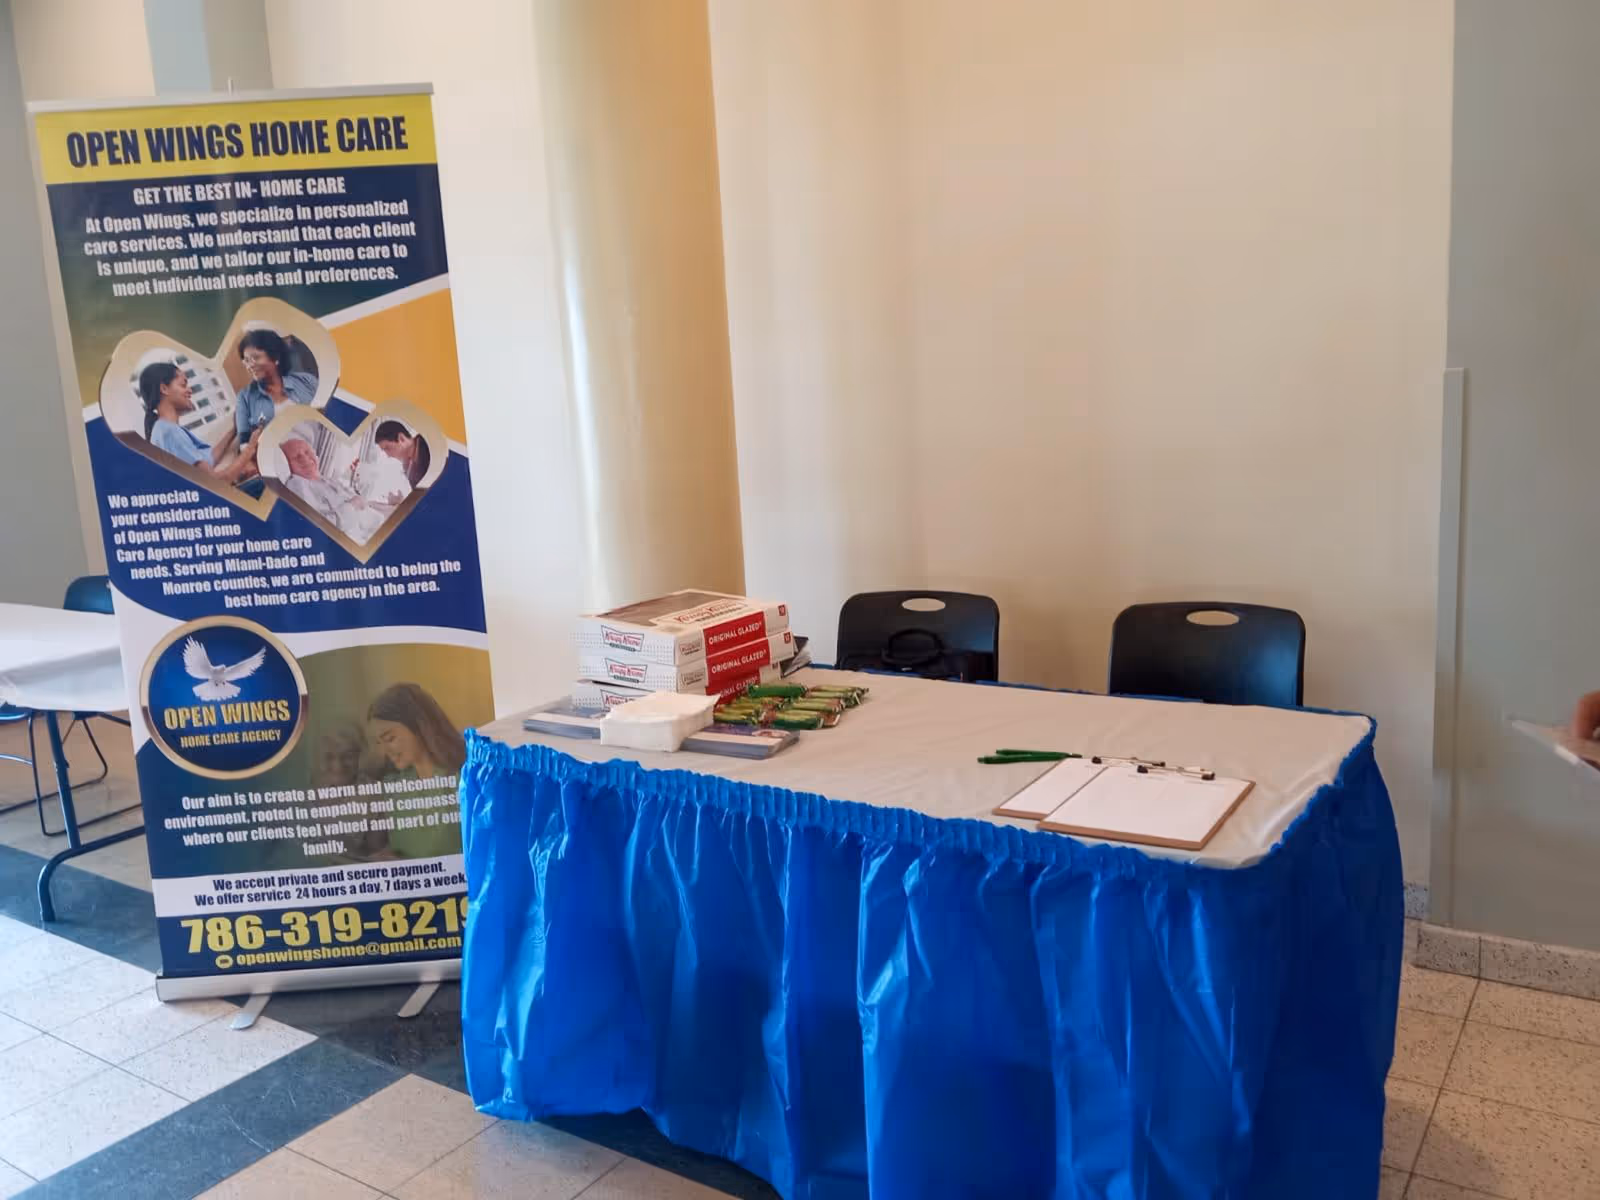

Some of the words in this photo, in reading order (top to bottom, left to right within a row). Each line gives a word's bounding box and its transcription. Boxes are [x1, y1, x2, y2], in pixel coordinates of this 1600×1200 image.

[66, 129, 141, 168] OPEN
[144, 123, 245, 163] WINGS
[249, 119, 331, 157] HOME
[336, 115, 409, 153] CARE
[133, 187, 160, 205] GET
[164, 185, 193, 203] THE
[194, 182, 233, 201] BEST
[235, 181, 257, 199] IN-
[260, 178, 304, 197] HOME
[306, 176, 346, 195] CARE
[85, 218, 101, 234] At
[103, 216, 142, 234] Open
[143, 213, 195, 231] Wings,
[196, 213, 218, 227] we
[221, 205, 293, 226] specialize
[297, 205, 312, 220] in
[314, 199, 409, 220] personalized
[84, 240, 118, 256] care
[120, 236, 188, 253] services.
[189, 232, 214, 249] We
[216, 226, 299, 246] understand
[302, 224, 332, 241] that
[334, 223, 371, 239] each
[373, 221, 417, 238] client
[114, 259, 169, 275] unique,
[171, 254, 199, 271] and
[201, 255, 223, 270] we
[225, 250, 263, 267] tailor
[267, 249, 291, 265] our
[294, 246, 354, 263] in-home
[357, 245, 390, 260] care
[392, 243, 408, 258] to
[112, 281, 151, 297] meet
[153, 274, 226, 294] individual
[228, 271, 273, 288] needs
[275, 269, 303, 286] and
[305, 266, 399, 285] preferences.
[107, 495, 129, 509] We
[131, 490, 199, 506] appreciate
[111, 514, 139, 528] your
[141, 506, 230, 526] consideration
[114, 531, 126, 545] of
[128, 529, 160, 545] Open
[161, 526, 203, 544] Wings
[204, 524, 241, 538] Home
[116, 549, 145, 563] Care
[147, 546, 193, 562] Agency
[195, 543, 213, 557] for
[215, 542, 244, 556] your
[246, 539, 279, 553] home
[282, 537, 312, 550] care
[130, 565, 172, 580] needs.
[174, 561, 223, 578] Serving
[225, 554, 298, 572] Miami-Dade
[301, 552, 325, 567] and
[162, 580, 211, 596] Monroe
[214, 575, 270, 592] counties,
[271, 574, 289, 587] we
[291, 572, 314, 586] are
[316, 564, 384, 584] committed
[386, 565, 398, 578] to
[402, 561, 438, 577] being
[440, 560, 461, 573] the
[224, 595, 253, 608] best
[255, 592, 288, 606] home
[290, 591, 319, 604] care
[322, 586, 367, 602] agency
[369, 584, 382, 598] in
[384, 582, 406, 596] the
[408, 580, 440, 594] area.
[709, 631, 737, 645] ORIGINAL
[711, 658, 741, 674] ORIGINAL
[164, 704, 217, 730] OPEN
[220, 700, 291, 724] WINGS
[180, 735, 211, 748] HOME
[212, 732, 240, 745] CARE
[242, 729, 281, 742] AGENCY
[182, 796, 205, 810] Our
[208, 794, 232, 808] aim
[234, 792, 247, 805] is
[248, 792, 262, 804] to
[265, 789, 305, 803] create
[307, 790, 316, 800] a
[318, 786, 356, 799] warm
[358, 781, 382, 795] and
[384, 776, 457, 793] welcoming
[252, 807, 294, 822] rooted
[296, 807, 308, 819] in
[310, 801, 368, 818] empathy
[370, 799, 394, 813] and
[397, 792, 460, 811] compassi
[183, 832, 224, 846] where
[226, 830, 248, 843] our
[251, 826, 295, 841] clients
[296, 823, 322, 837] feel
[324, 818, 368, 835] valued
[370, 816, 395, 831] and
[397, 815, 424, 831] part
[426, 811, 439, 825] of
[303, 840, 347, 856] family.
[213, 880, 232, 891] We
[235, 876, 275, 890] accept
[278, 873, 319, 887] private
[322, 870, 344, 883] and
[347, 867, 388, 881] secure
[391, 861, 446, 878] payment.
[194, 895, 214, 906] We
[217, 893, 245, 905] offer
[247, 890, 291, 902] service
[296, 888, 309, 899] 24
[312, 885, 347, 898] hours
[350, 884, 357, 894] a
[384, 880, 391, 892] 7
[393, 878, 421, 891] days
[424, 878, 431, 888] a
[237, 936, 462, 966] openwingshome@gmail.com
